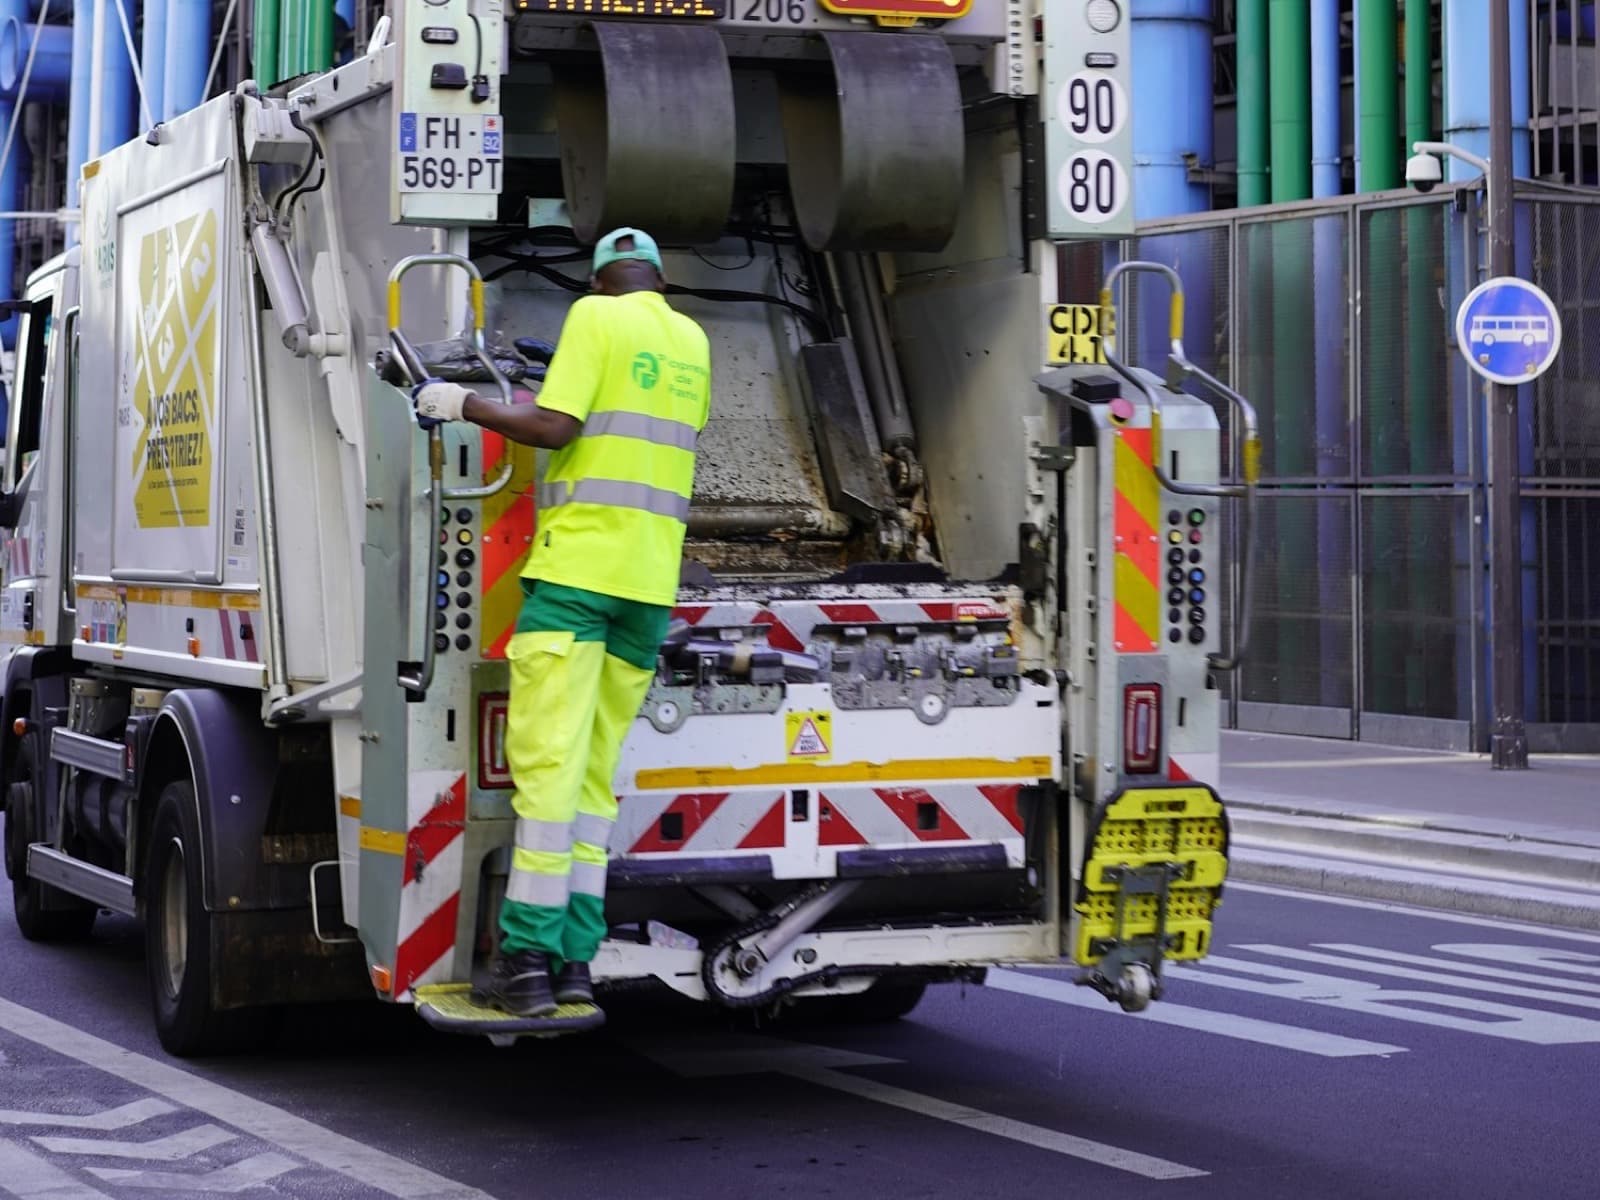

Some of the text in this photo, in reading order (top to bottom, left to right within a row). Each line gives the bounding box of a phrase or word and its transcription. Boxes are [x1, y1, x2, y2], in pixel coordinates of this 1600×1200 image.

[1070, 78, 1115, 134] 90
[404, 156, 502, 190] 569-PT
[1070, 157, 1115, 213] 80
